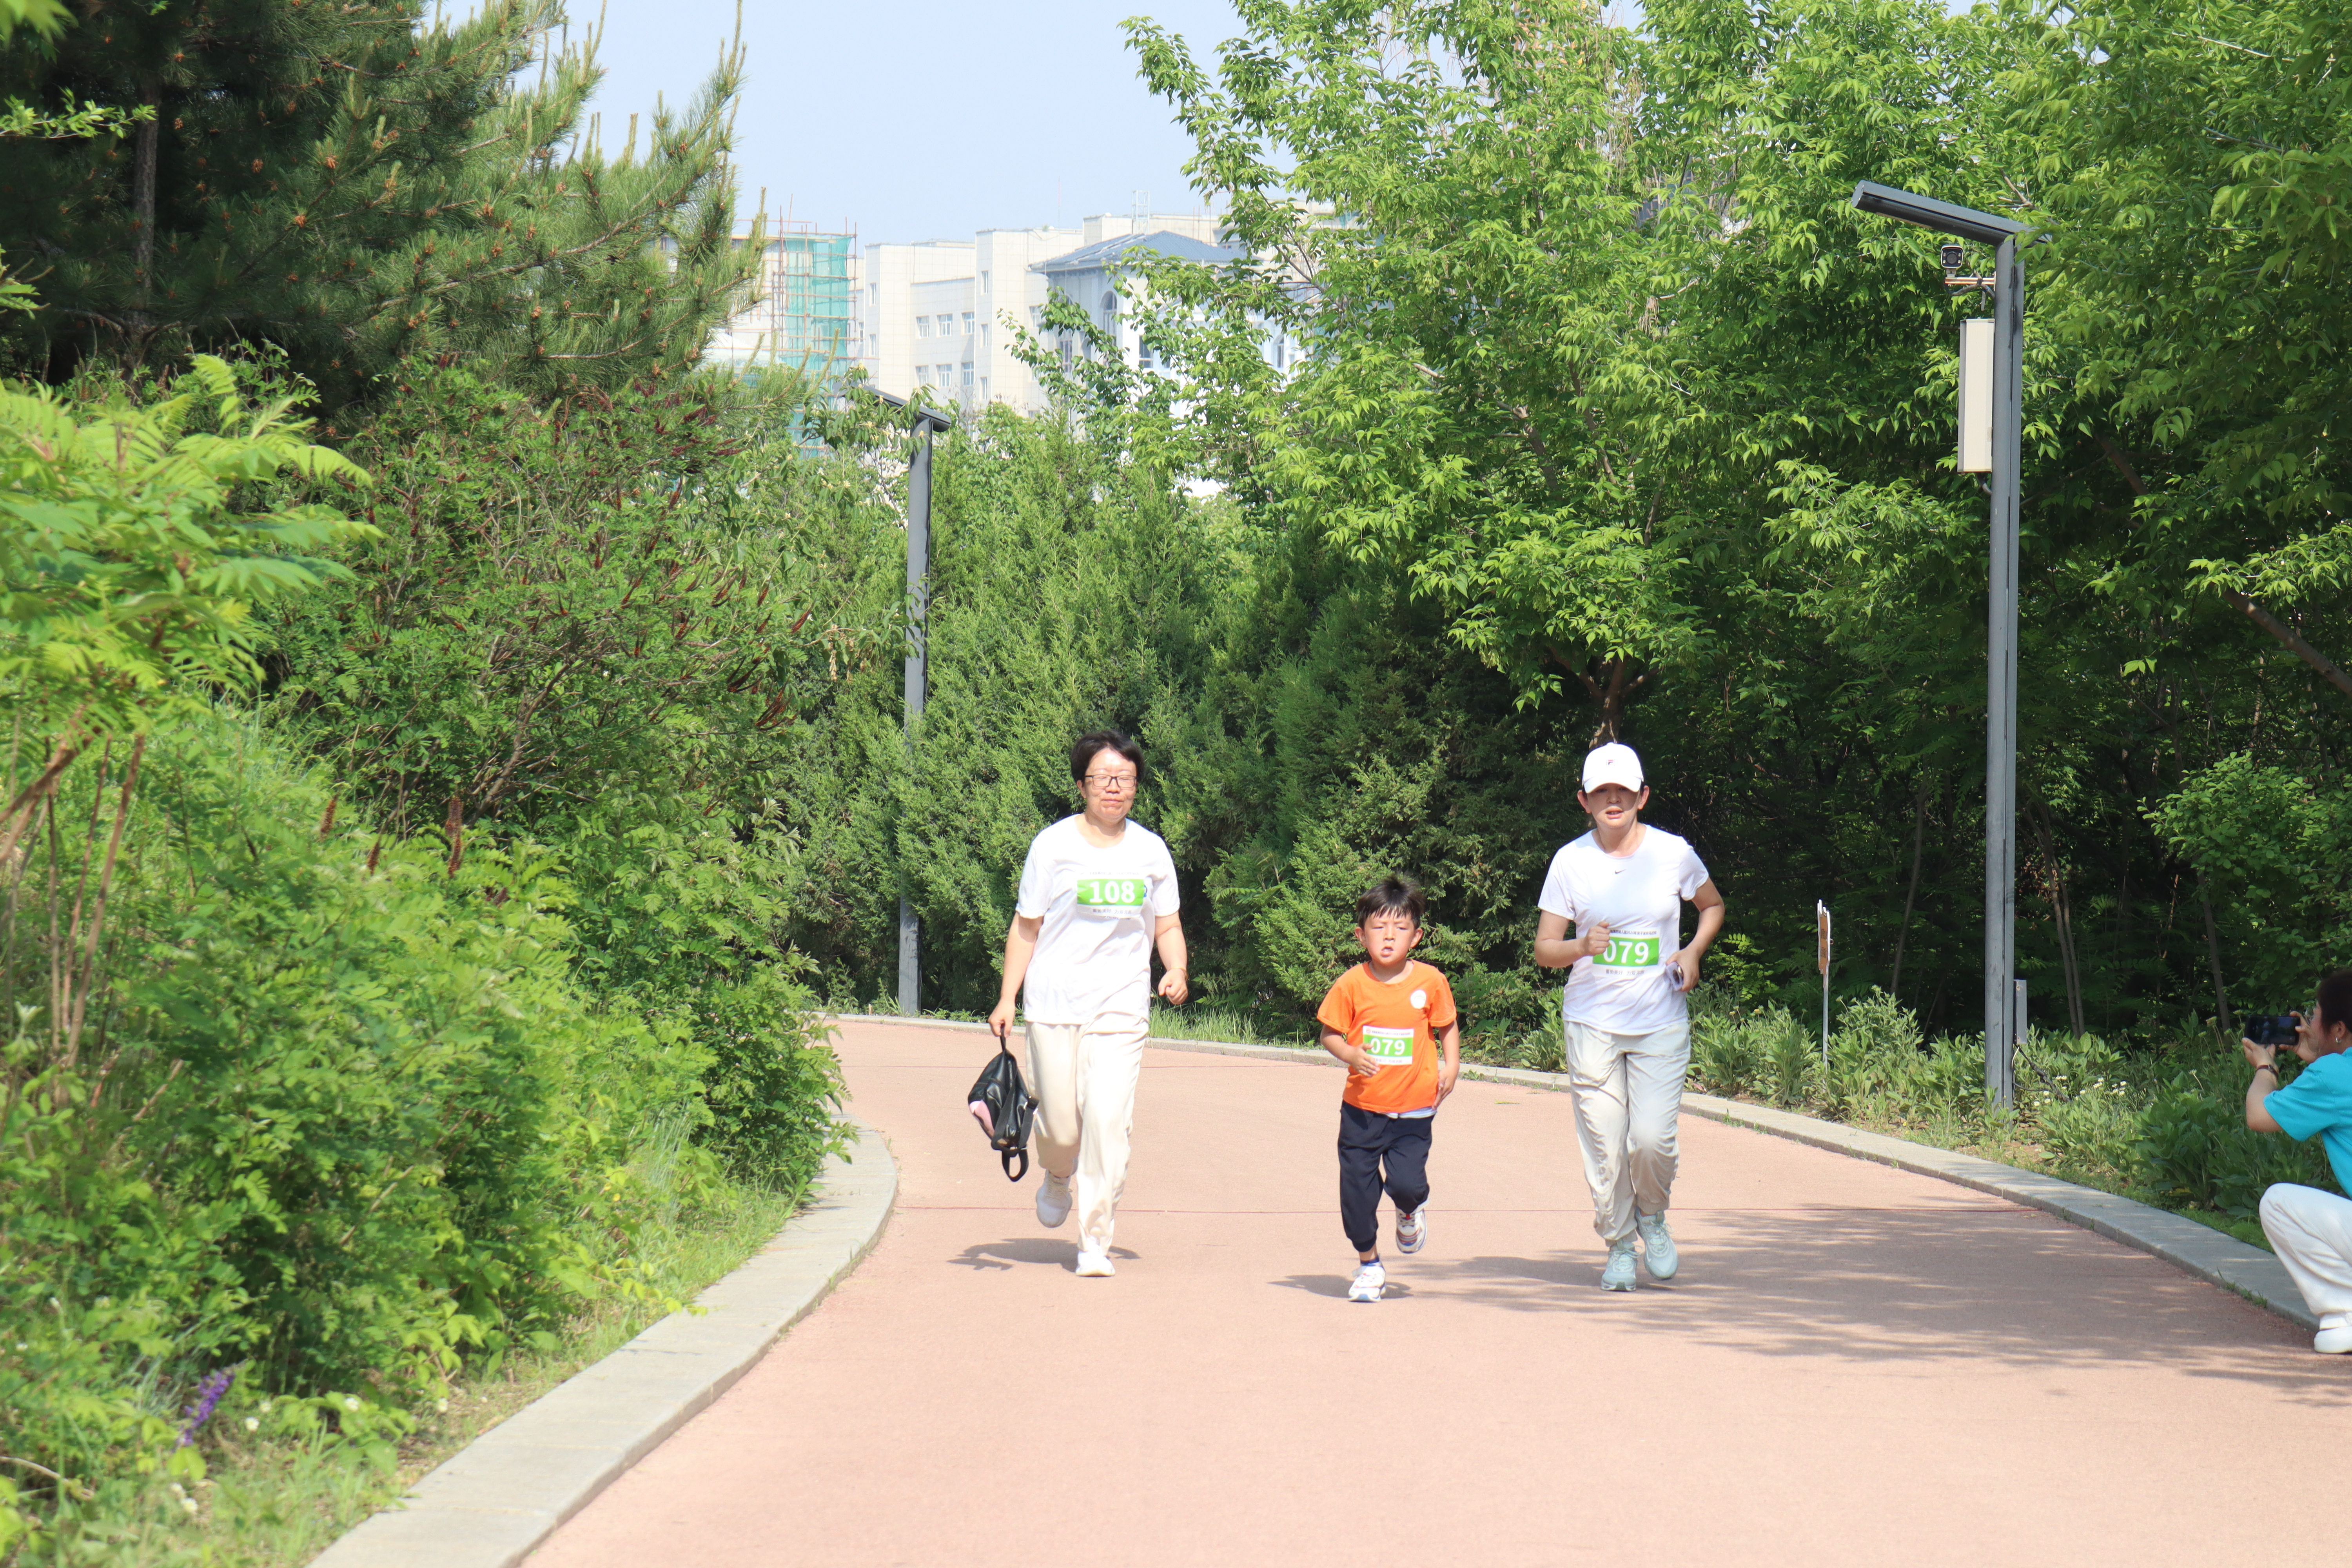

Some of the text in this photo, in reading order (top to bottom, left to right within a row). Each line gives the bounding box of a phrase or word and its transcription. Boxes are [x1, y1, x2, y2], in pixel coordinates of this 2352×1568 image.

[1089, 881, 1135, 904] 108
[1603, 940, 1649, 964] 079
[1370, 1037, 1405, 1056] 079
